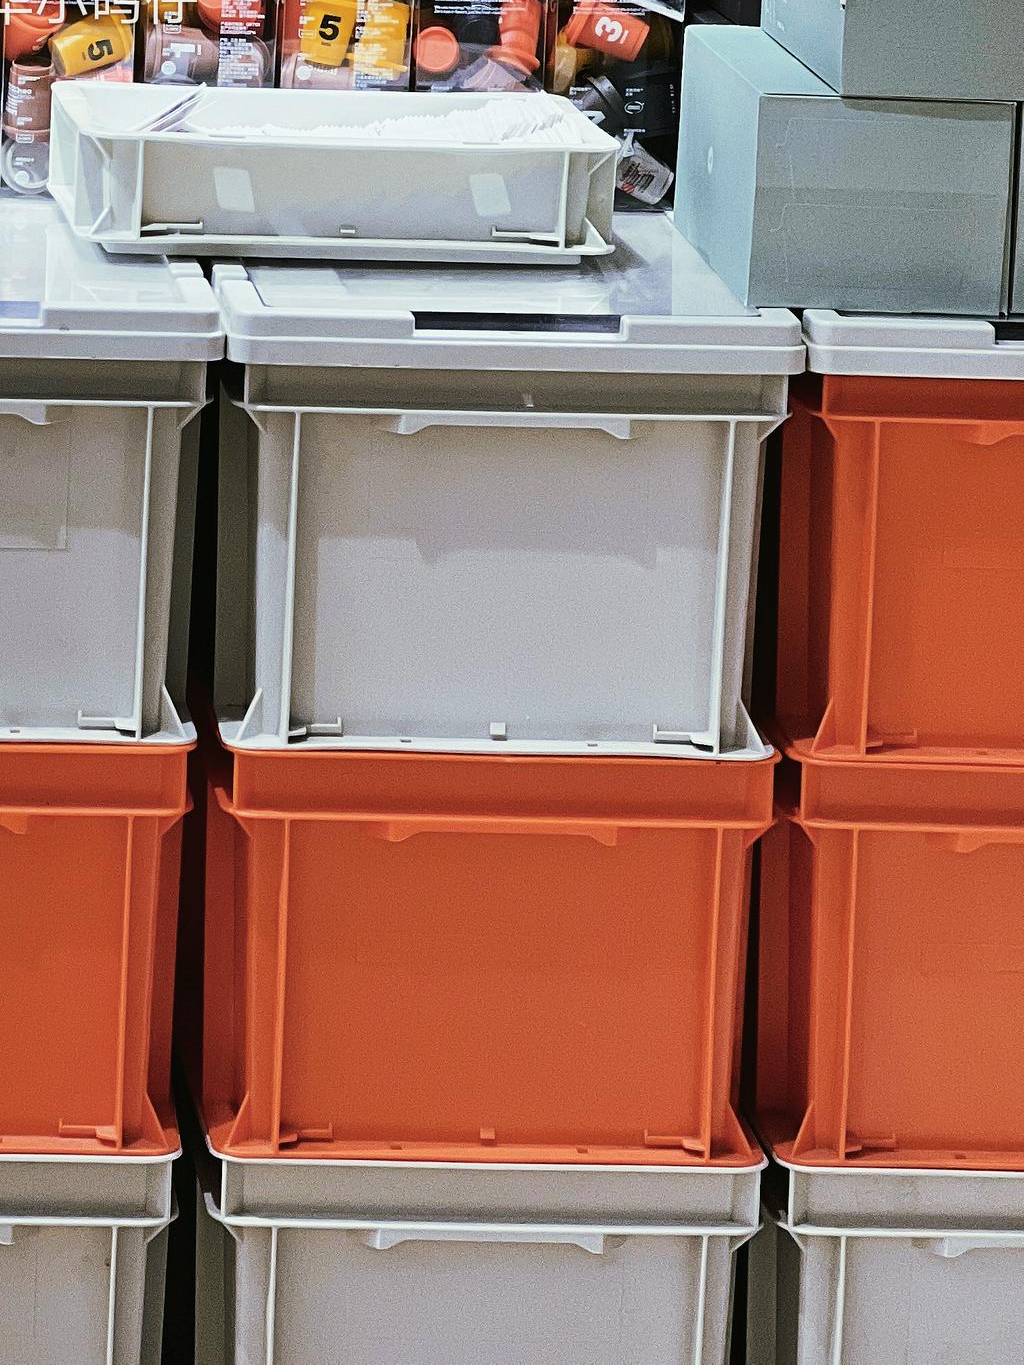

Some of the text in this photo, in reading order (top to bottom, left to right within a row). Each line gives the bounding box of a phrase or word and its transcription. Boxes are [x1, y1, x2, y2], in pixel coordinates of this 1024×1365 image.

[318, 13, 342, 41] 5
[594, 16, 623, 42] 3
[87, 39, 114, 61] 5
